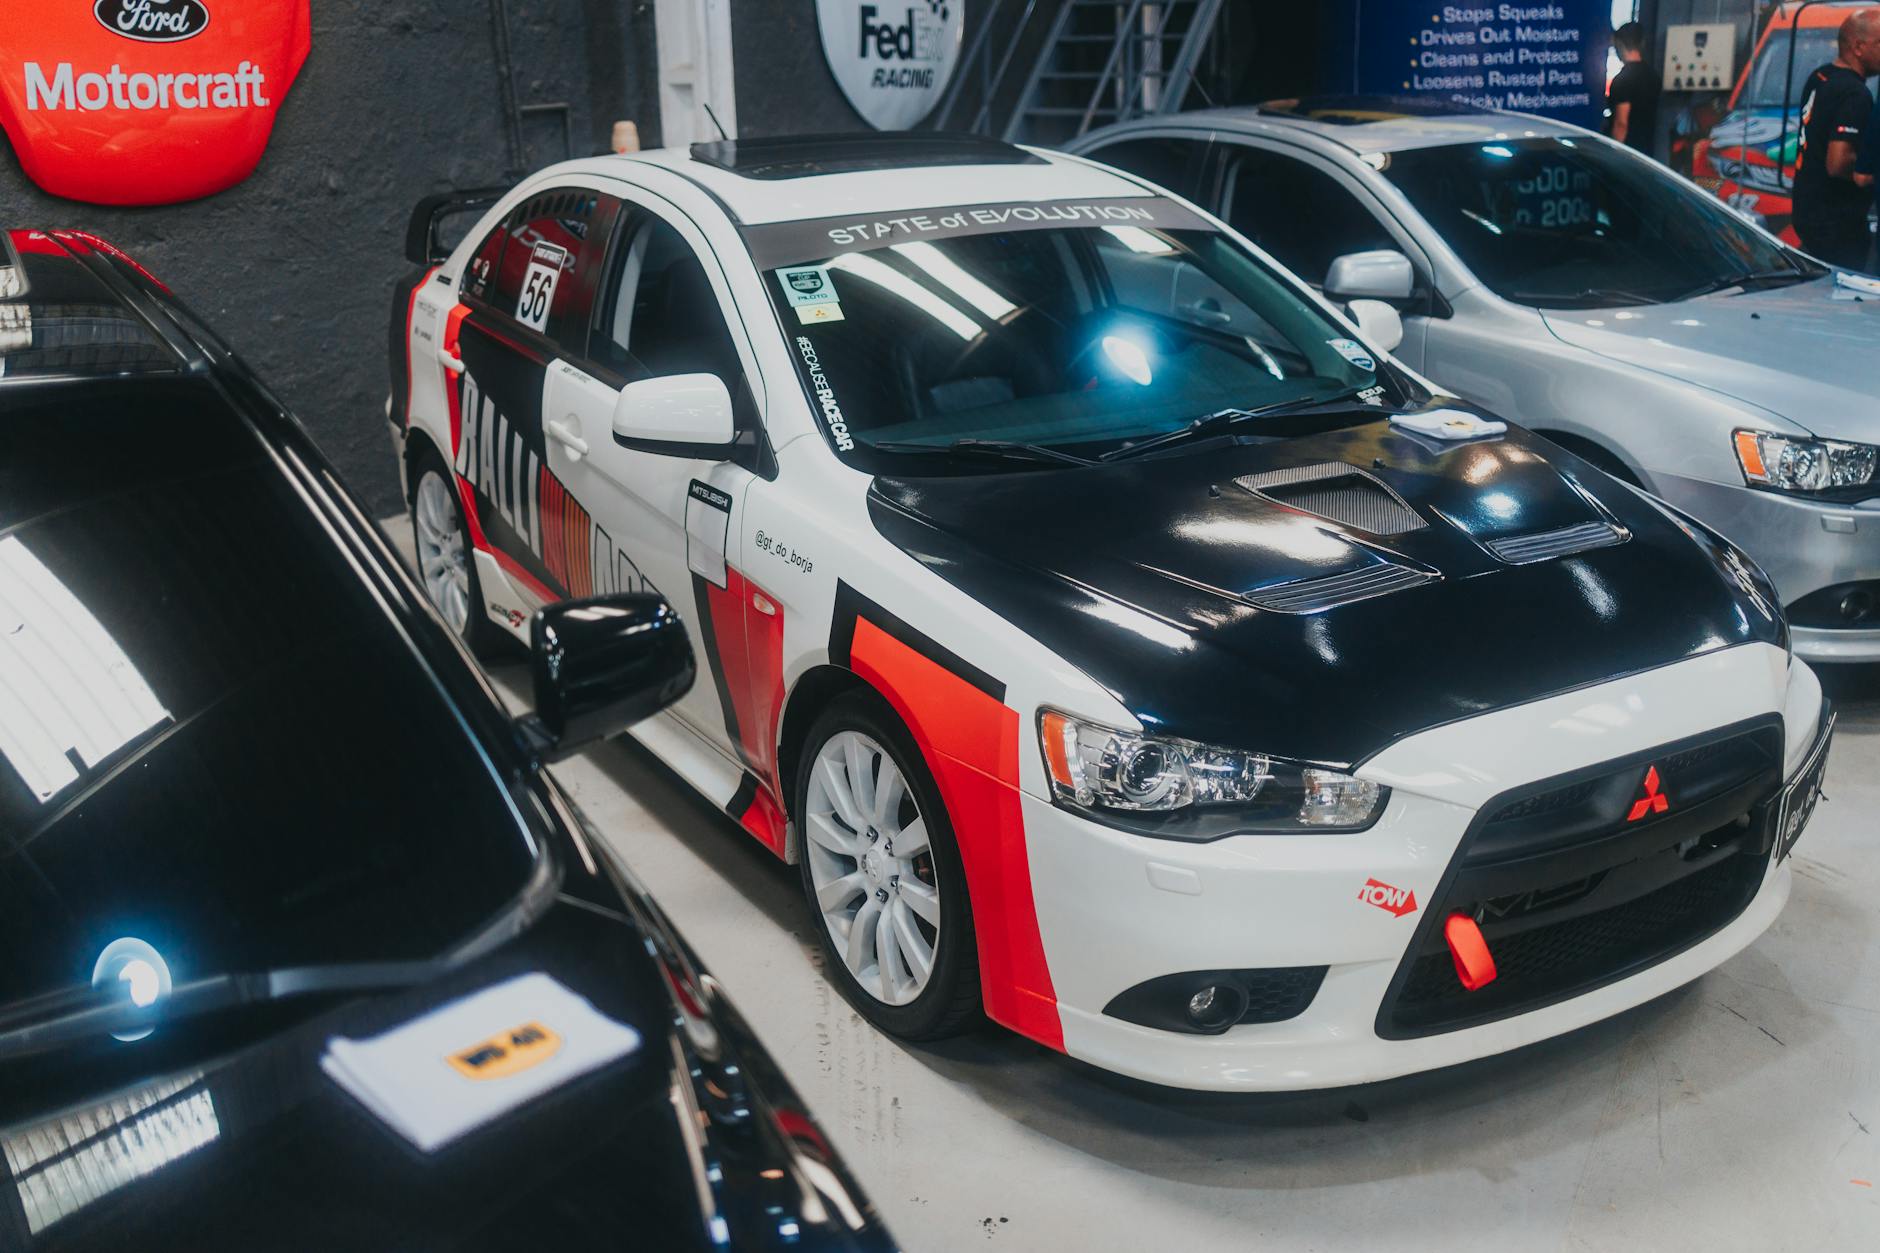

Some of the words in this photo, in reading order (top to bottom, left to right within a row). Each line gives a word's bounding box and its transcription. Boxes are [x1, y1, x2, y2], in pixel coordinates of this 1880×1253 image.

[117, 0, 190, 32] Ford
[1443, 6, 1495, 25] Stops
[1498, 4, 1564, 22] Squeaks
[1420, 29, 1476, 46] Drives
[1479, 27, 1511, 43] Out
[1515, 26, 1580, 43] Moisture
[1420, 51, 1479, 68] Cleans
[1482, 50, 1514, 65] and
[1518, 48, 1579, 64] Protects
[24, 61, 265, 111] Motorcraft
[871, 68, 935, 89] RACING
[1413, 74, 1484, 90] Loosens
[1488, 70, 1545, 88] Rusted
[1547, 69, 1583, 86] Parts
[828, 215, 933, 246] STATE
[940, 212, 965, 230] of
[969, 205, 1156, 226] EVOLUTION
[521, 270, 552, 324] 56
[692, 485, 729, 508] MITSUBISHI
[755, 530, 814, 574] @gt_do_borja
[1361, 885, 1408, 908] TOW
